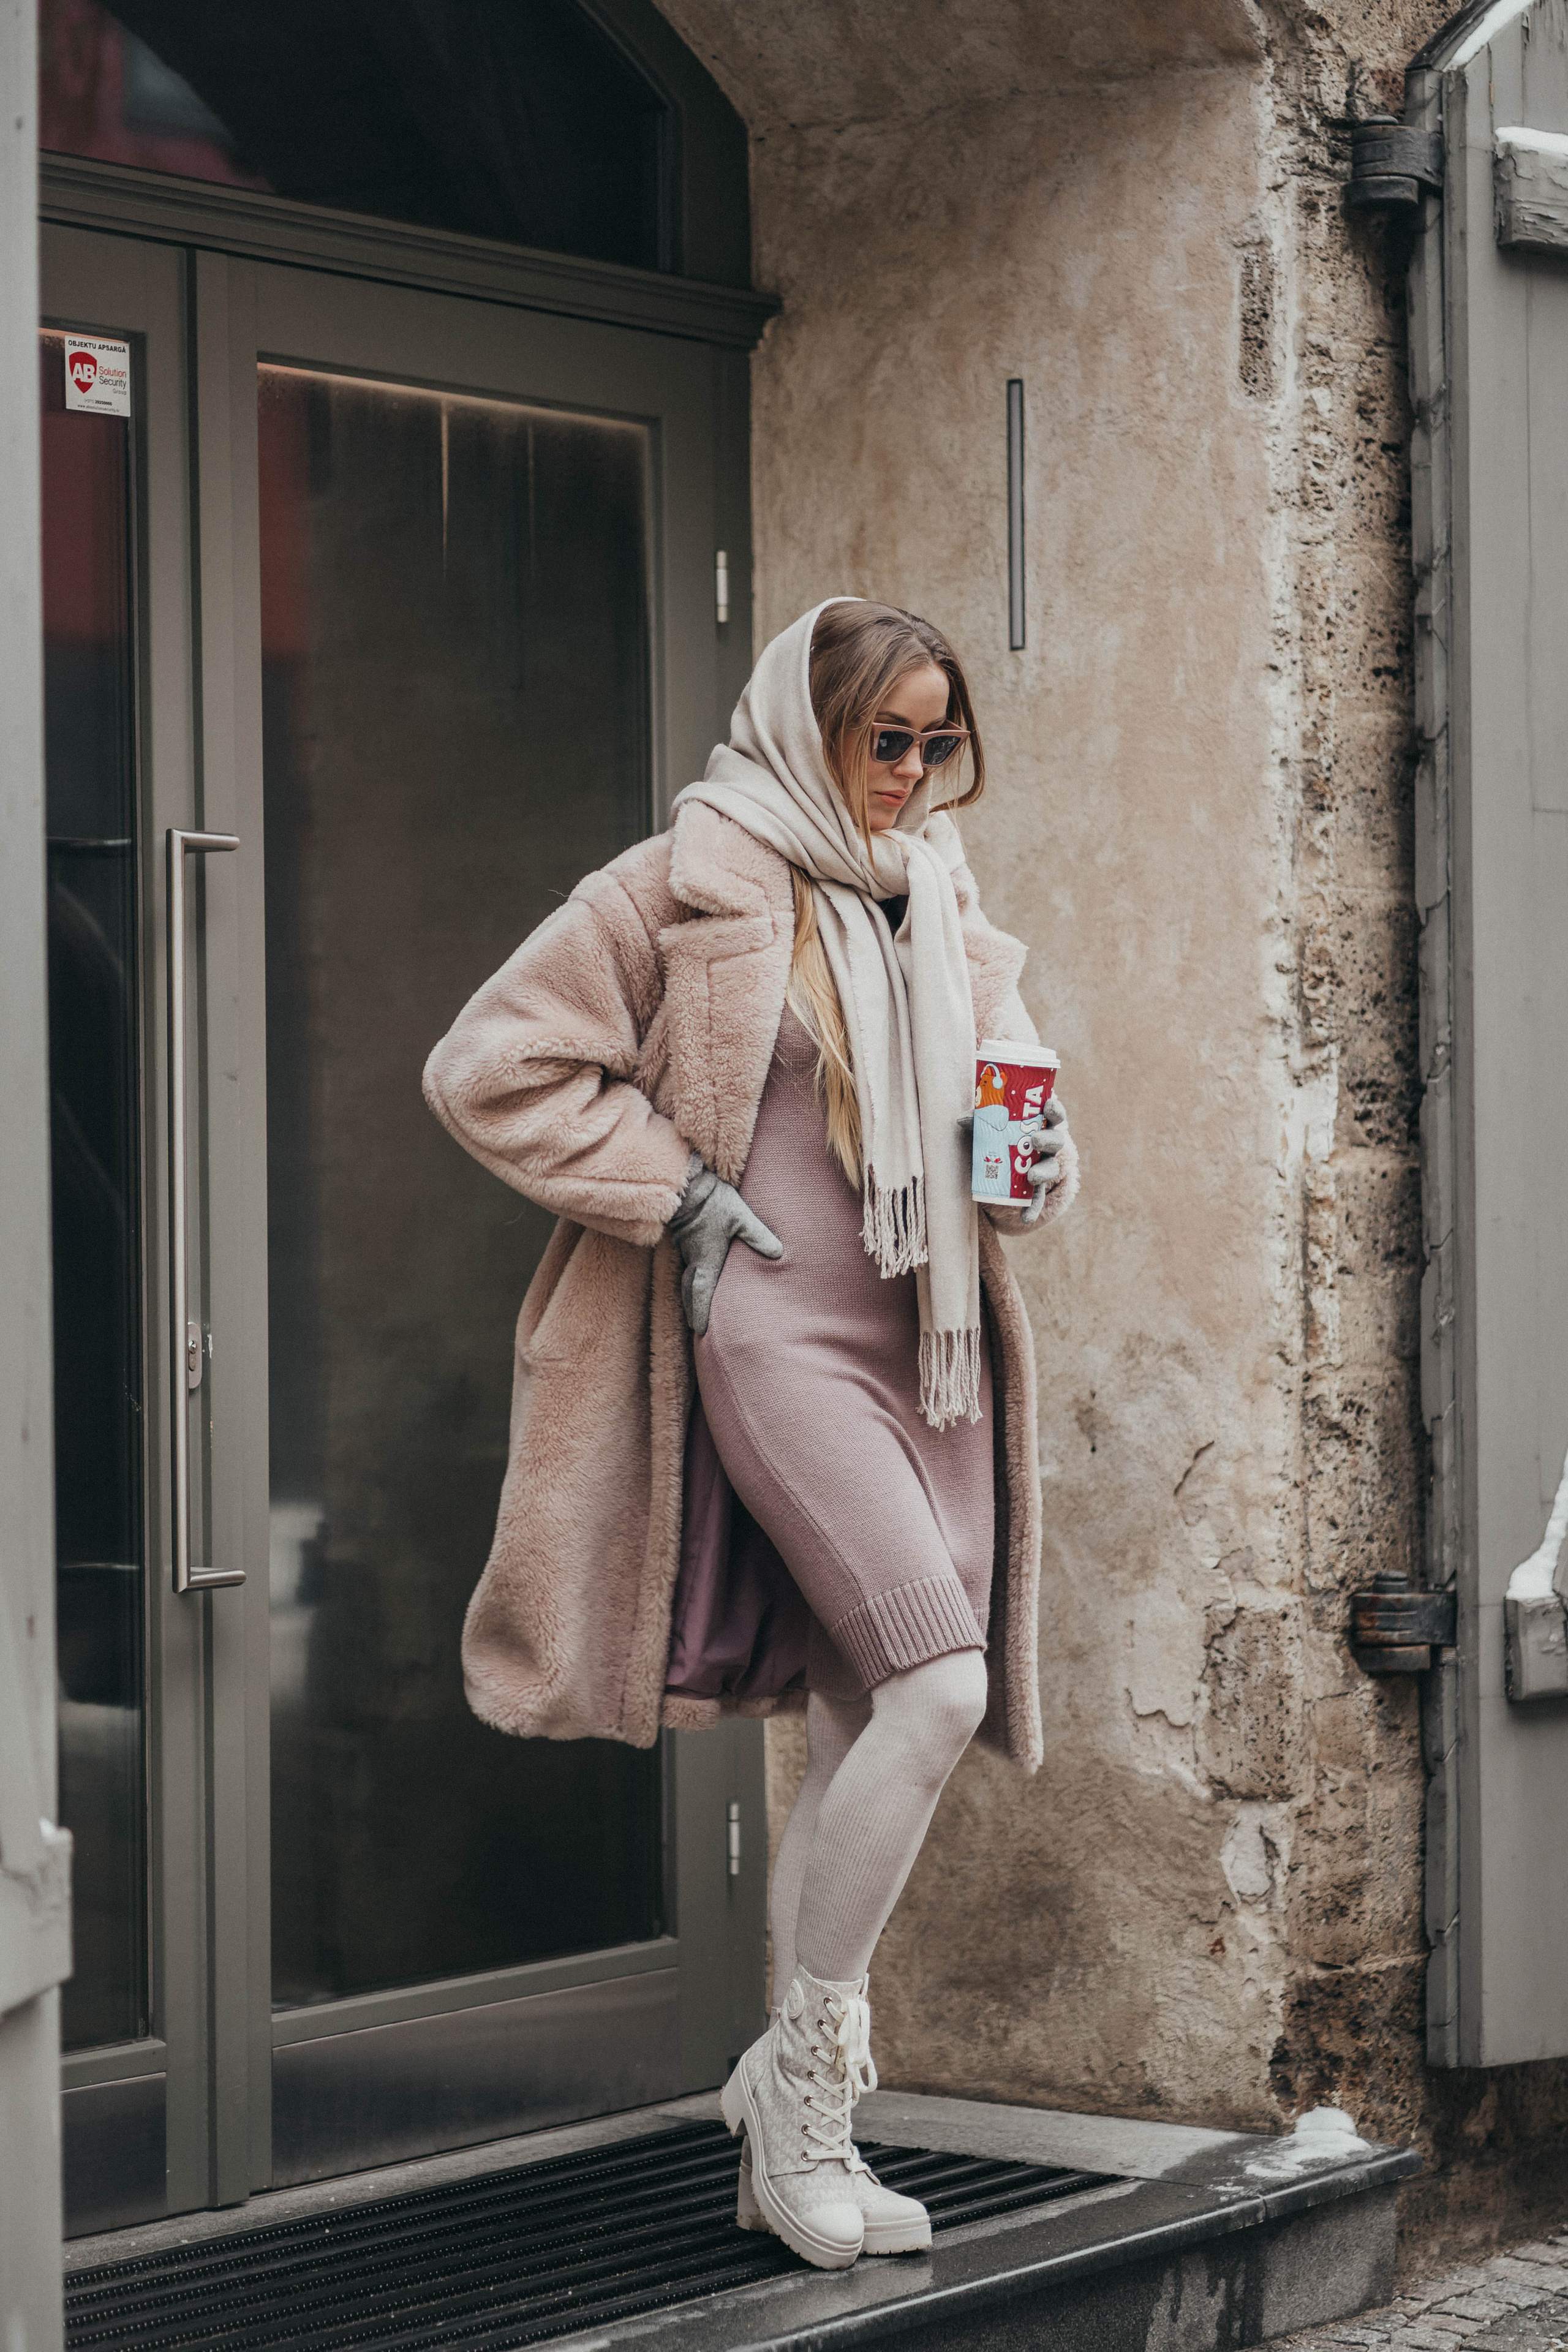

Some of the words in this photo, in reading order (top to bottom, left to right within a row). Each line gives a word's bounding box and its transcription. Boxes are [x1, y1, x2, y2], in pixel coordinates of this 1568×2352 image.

[68, 339, 96, 349] OBJEKTU
[71, 363, 96, 383] AB
[99, 366, 126, 378] Solution
[99, 375, 126, 390] Security
[1014, 1085, 1044, 1174] COSTA
